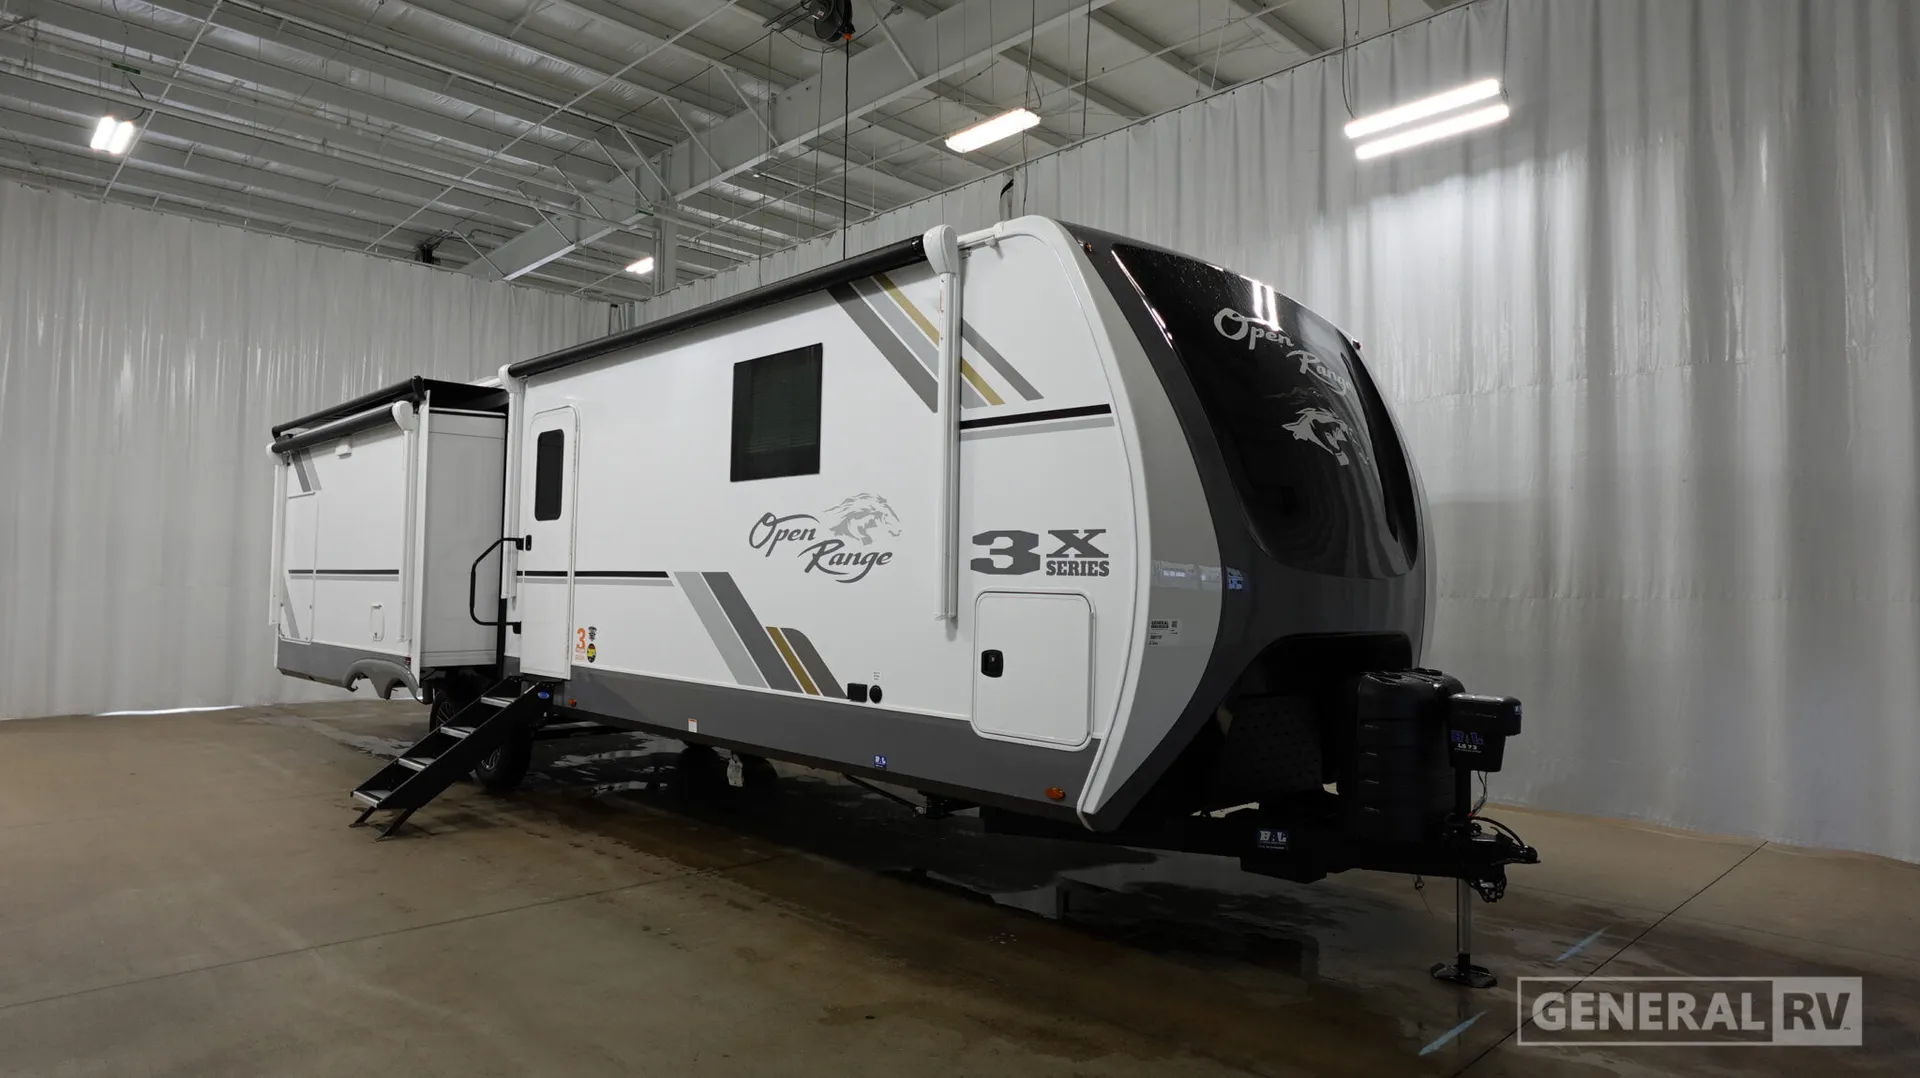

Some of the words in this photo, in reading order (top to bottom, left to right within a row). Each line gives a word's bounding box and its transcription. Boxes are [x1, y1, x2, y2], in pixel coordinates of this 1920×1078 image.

[1214, 307, 1295, 350] Open
[1286, 350, 1352, 396] Range
[749, 512, 820, 558] Open
[970, 530, 1041, 575] 3
[1046, 529, 1109, 558] X
[797, 539, 893, 584] Range
[1046, 560, 1110, 577] SERIES
